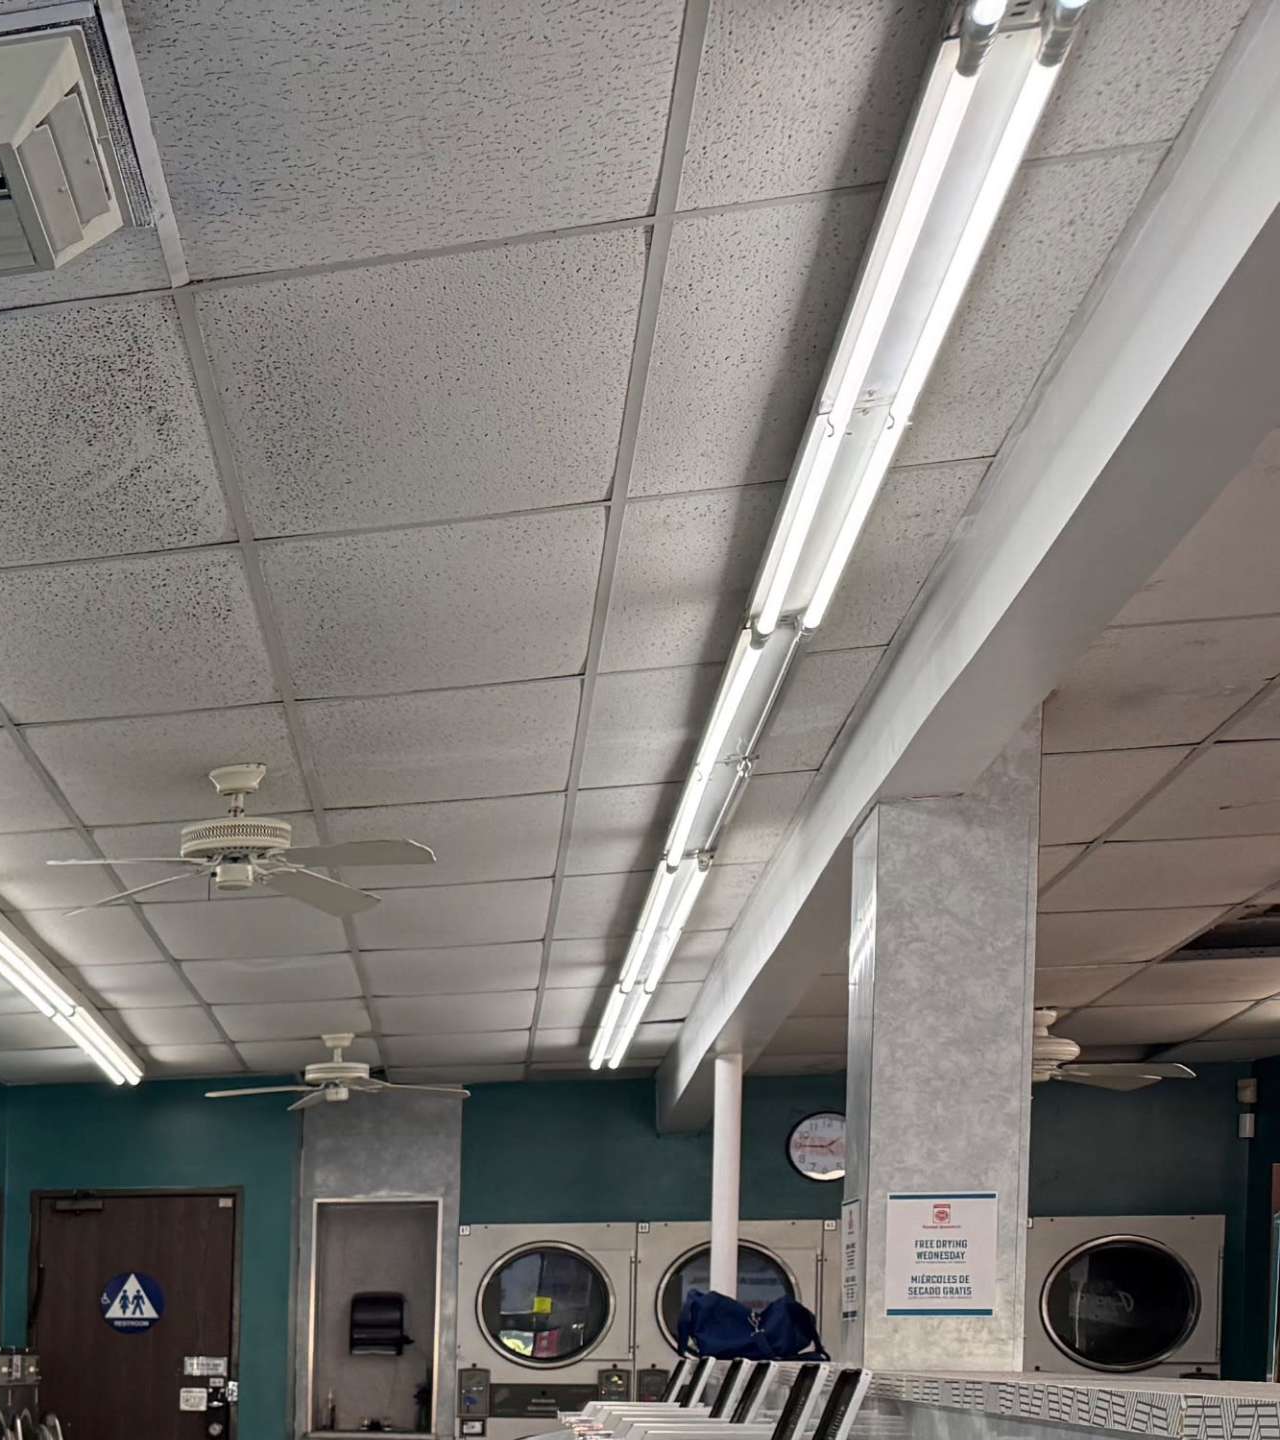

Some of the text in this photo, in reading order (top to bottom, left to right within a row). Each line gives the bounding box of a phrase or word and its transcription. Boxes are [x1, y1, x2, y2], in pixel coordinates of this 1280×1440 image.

[914, 1239, 968, 1249] FREE DRYING
[916, 1251, 966, 1260] WEDNESDAY
[910, 1273, 970, 1284] MIÉRCOLES DE
[908, 1286, 973, 1296] SECADO GRATIS
